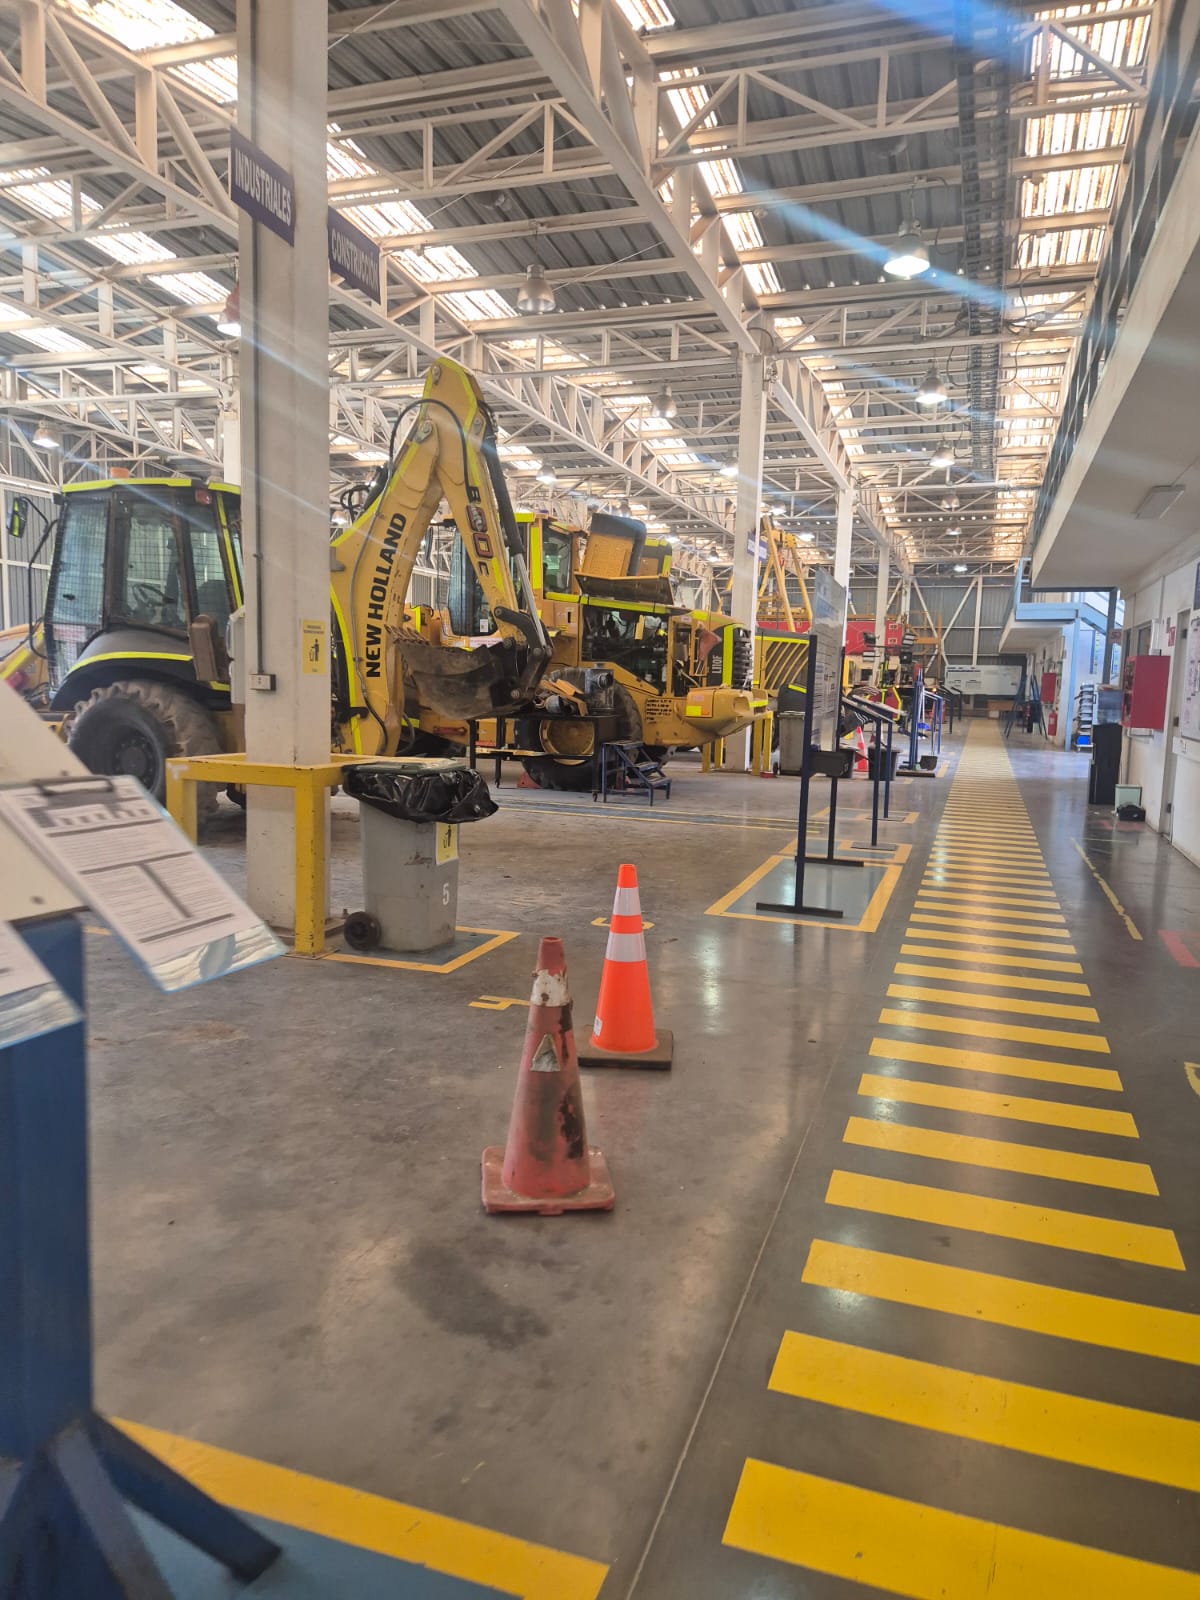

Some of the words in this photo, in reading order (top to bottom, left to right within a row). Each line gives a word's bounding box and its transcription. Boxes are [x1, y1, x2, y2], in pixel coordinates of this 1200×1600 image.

[235, 147, 291, 227] INDUSTRIALES
[367, 512, 407, 621] HOLLAND
[366, 623, 382, 678] NEW
[442, 882, 450, 905] 5
